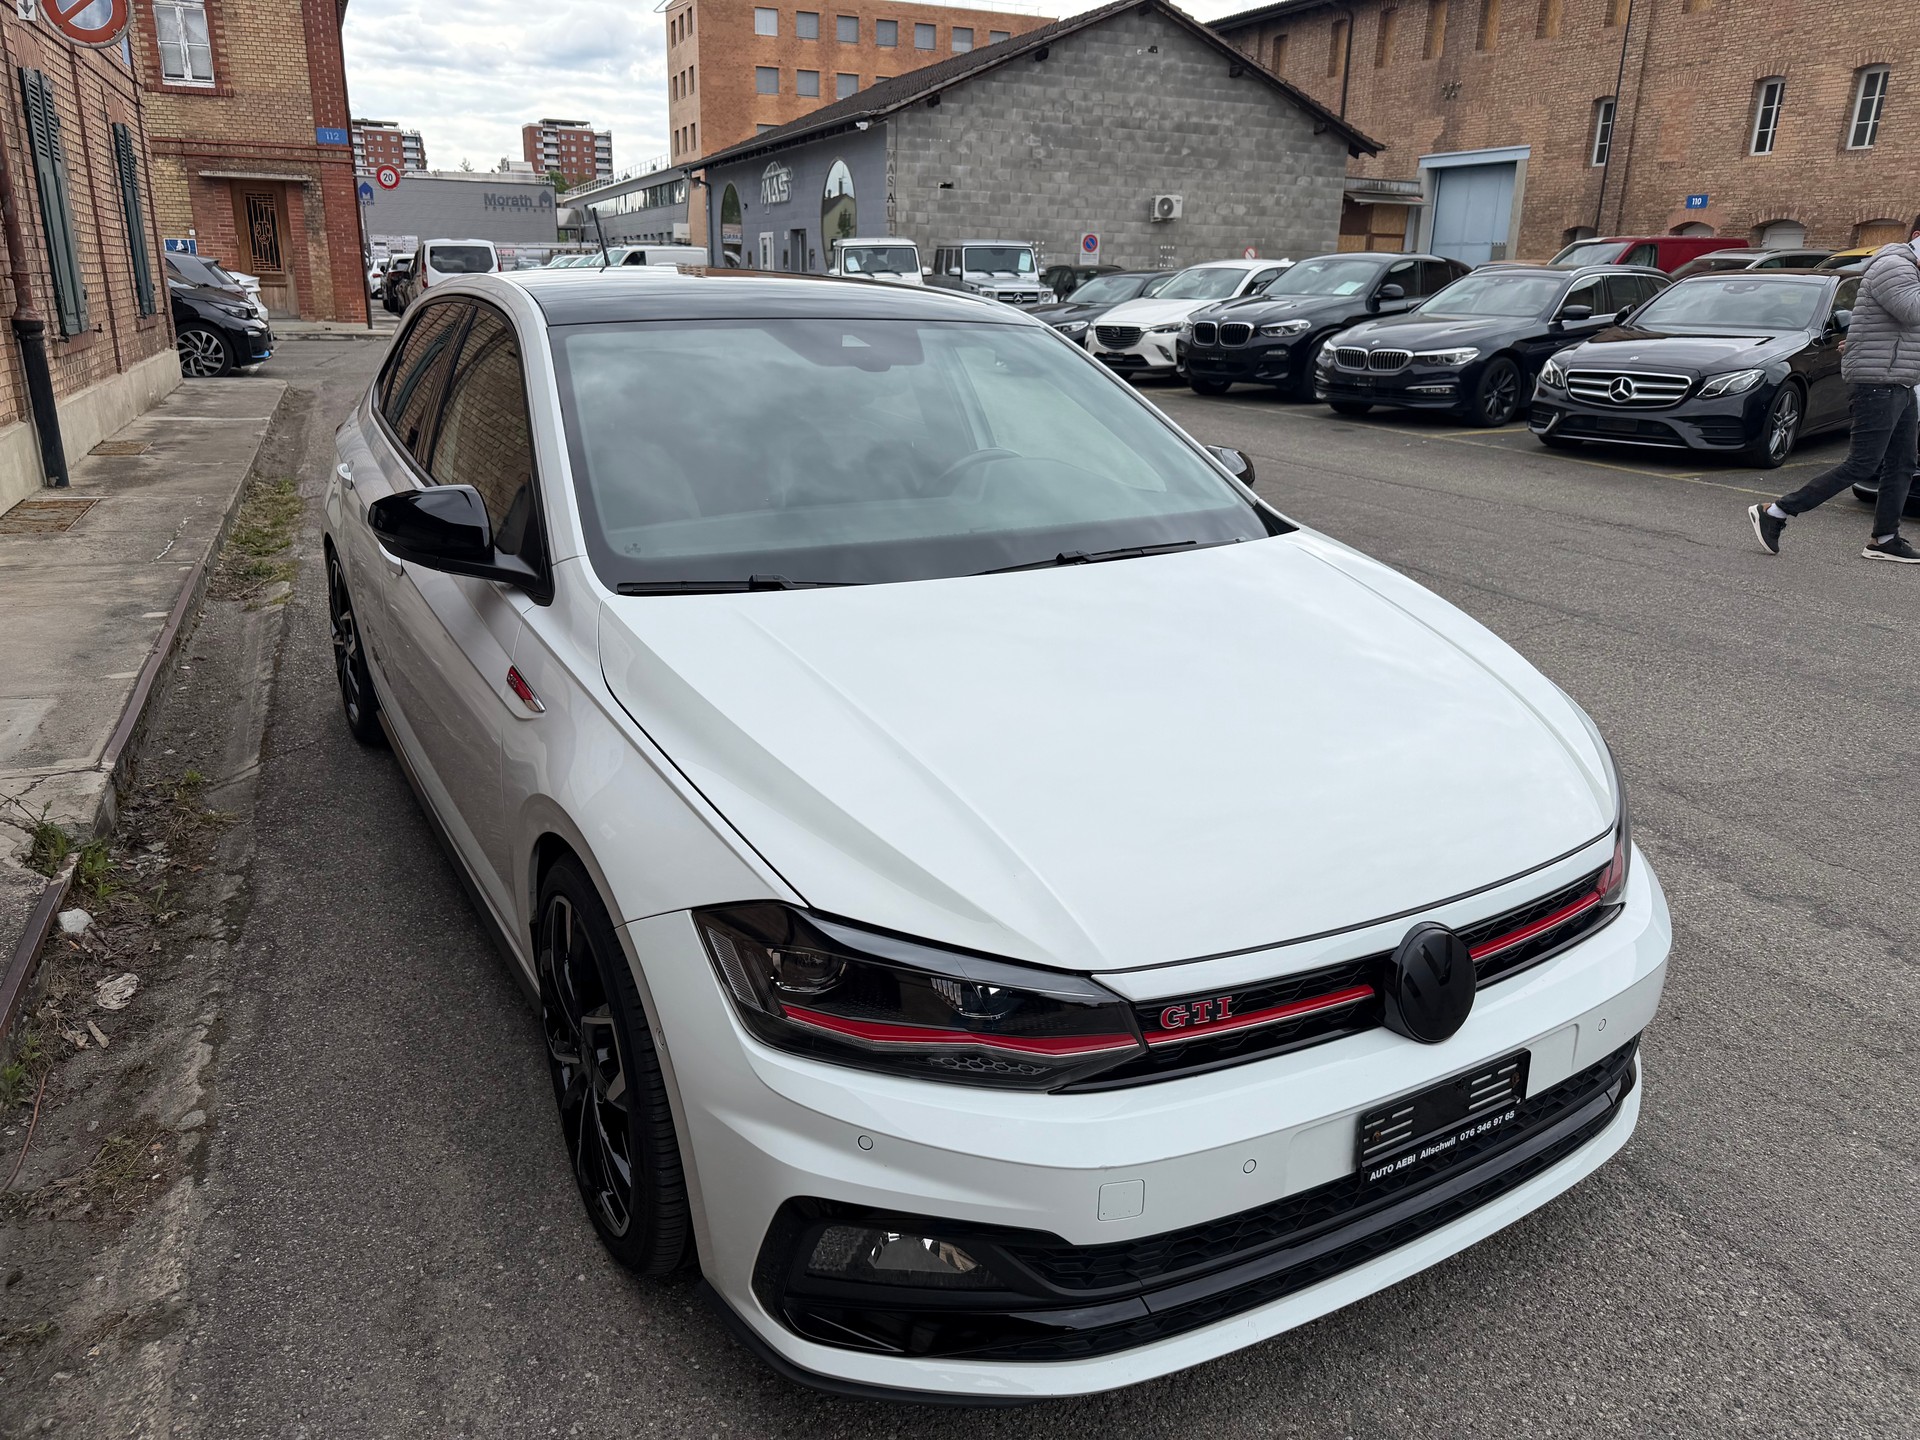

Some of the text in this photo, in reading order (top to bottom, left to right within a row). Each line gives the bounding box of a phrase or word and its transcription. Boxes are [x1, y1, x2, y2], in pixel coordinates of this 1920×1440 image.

[325, 131, 340, 141] 112
[383, 173, 393, 182] 20
[483, 192, 533, 208] Morath
[1692, 197, 1702, 206] 110
[1160, 995, 1233, 1030] GTI
[1369, 1110, 1515, 1182] AUTO AEBI Allschwil 076 346 97 65
